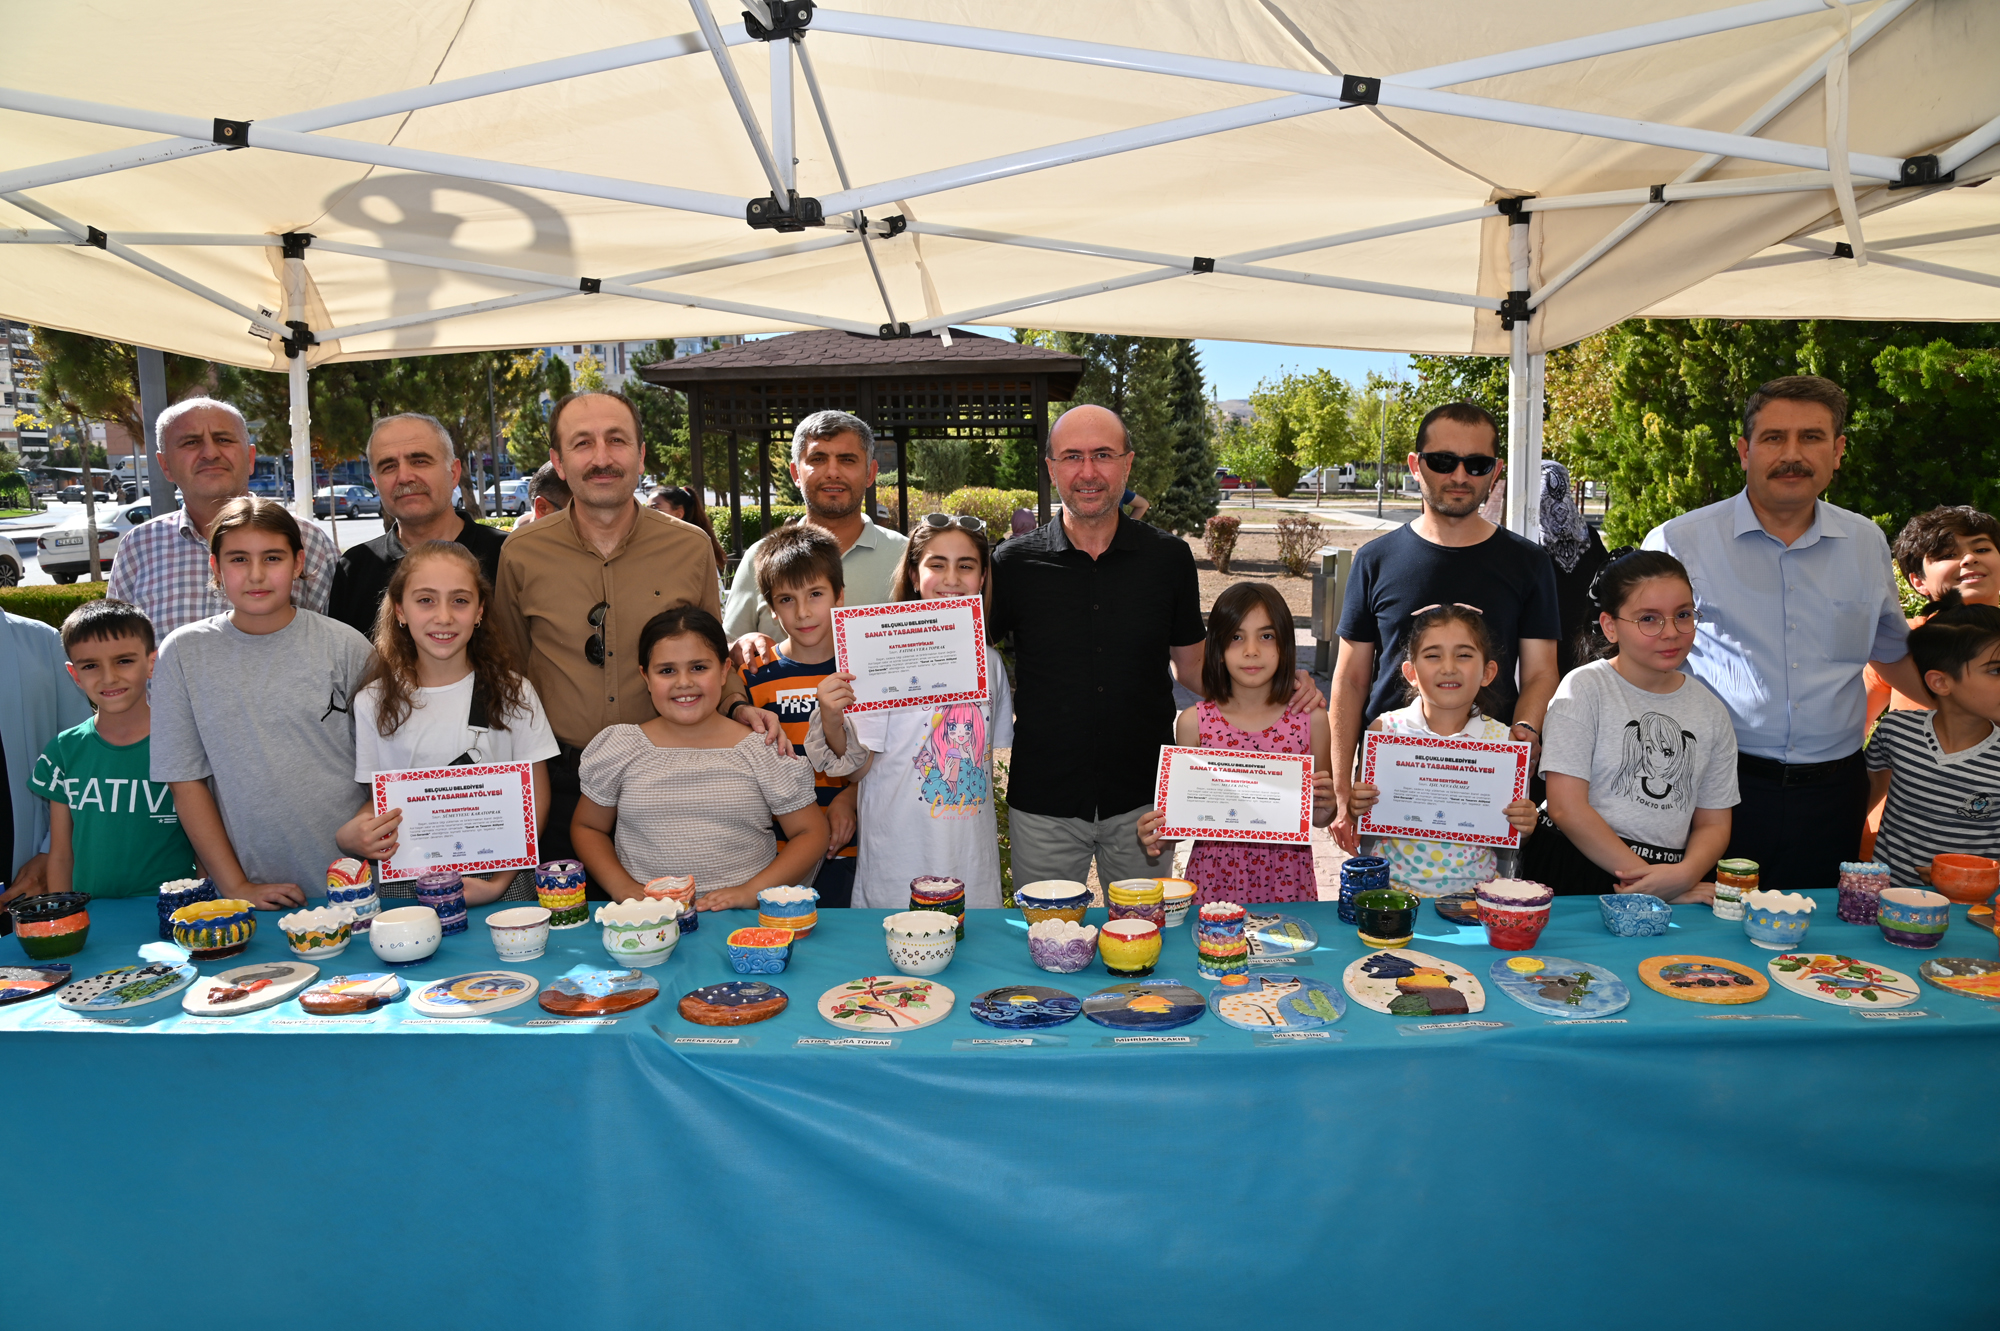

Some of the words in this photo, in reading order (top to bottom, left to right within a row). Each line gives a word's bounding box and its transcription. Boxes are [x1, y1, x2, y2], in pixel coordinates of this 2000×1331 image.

[909, 618, 938, 626] BELEDİYESİ
[893, 627, 923, 635] TASARIM
[924, 623, 956, 632] ATÖLYESİ
[1427, 763, 1458, 771] TASARIM
[1459, 766, 1495, 774] ATÖLYESİ
[32, 754, 177, 813] CREATIV
[437, 792, 468, 800] TASARIM
[469, 789, 502, 798] ATÖLYESİ
[930, 795, 982, 819] Coolest
[1636, 796, 1659, 809] TOKYO
[1630, 845, 1653, 858] GIRL
